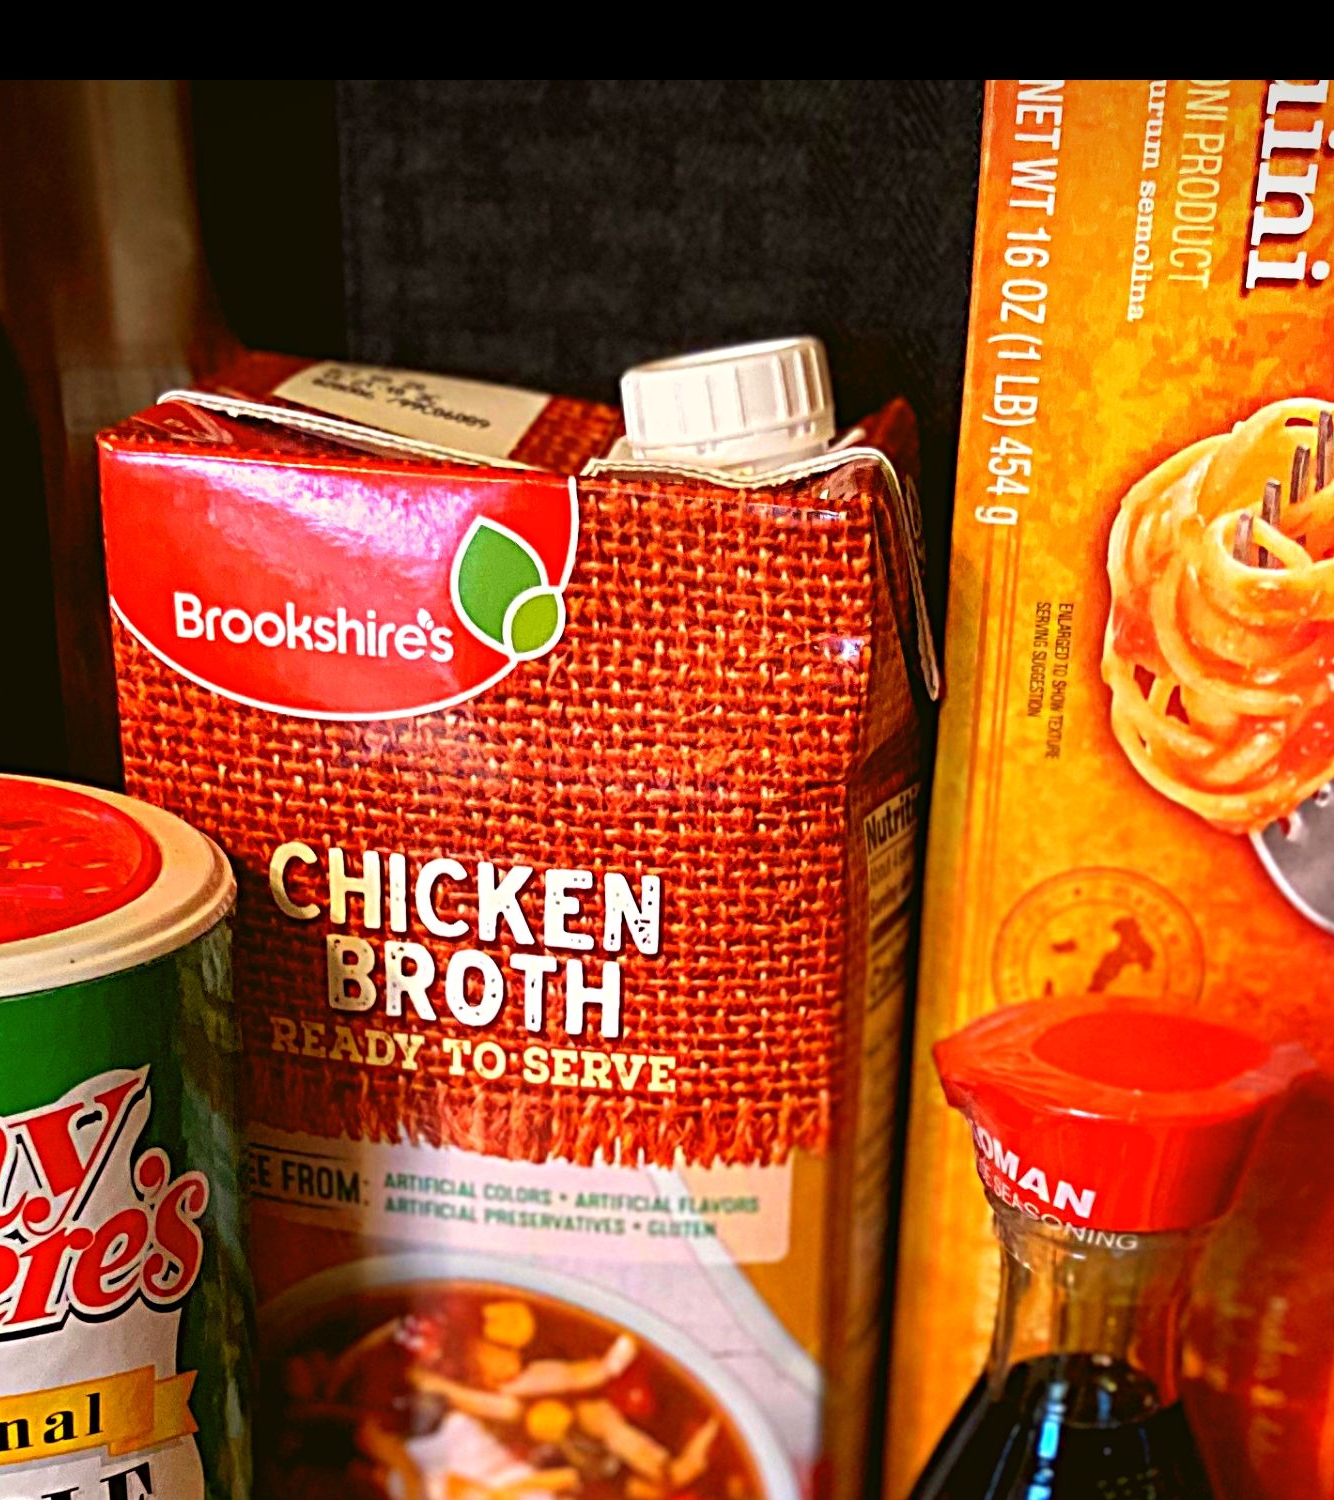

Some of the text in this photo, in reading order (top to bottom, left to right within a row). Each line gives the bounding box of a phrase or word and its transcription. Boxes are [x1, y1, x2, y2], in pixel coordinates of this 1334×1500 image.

[1127, 180, 1157, 321] semolina
[1168, 132, 1226, 290] PRODUCT
[975, 80, 1065, 526] NET WT 16 OZ (1 LB) 454 g
[175, 592, 455, 663] Brookshire's
[1027, 602, 1051, 717] SERVING SUGGESTION
[270, 841, 661, 955] CHICKEN
[327, 934, 623, 1038] BROTH
[269, 1016, 677, 1093] READY TO SERVE
[282, 1160, 369, 1204] FROM:
[384, 1171, 552, 1206] ARTIFICIAL COLORS
[575, 1190, 759, 1215] ARTIFICIAL FLAVORS
[972, 1125, 1096, 1219] OMAN
[385, 1196, 626, 1236] ARTIFICIAL PRESERVATIVES
[647, 1219, 716, 1238] GLUTEN
